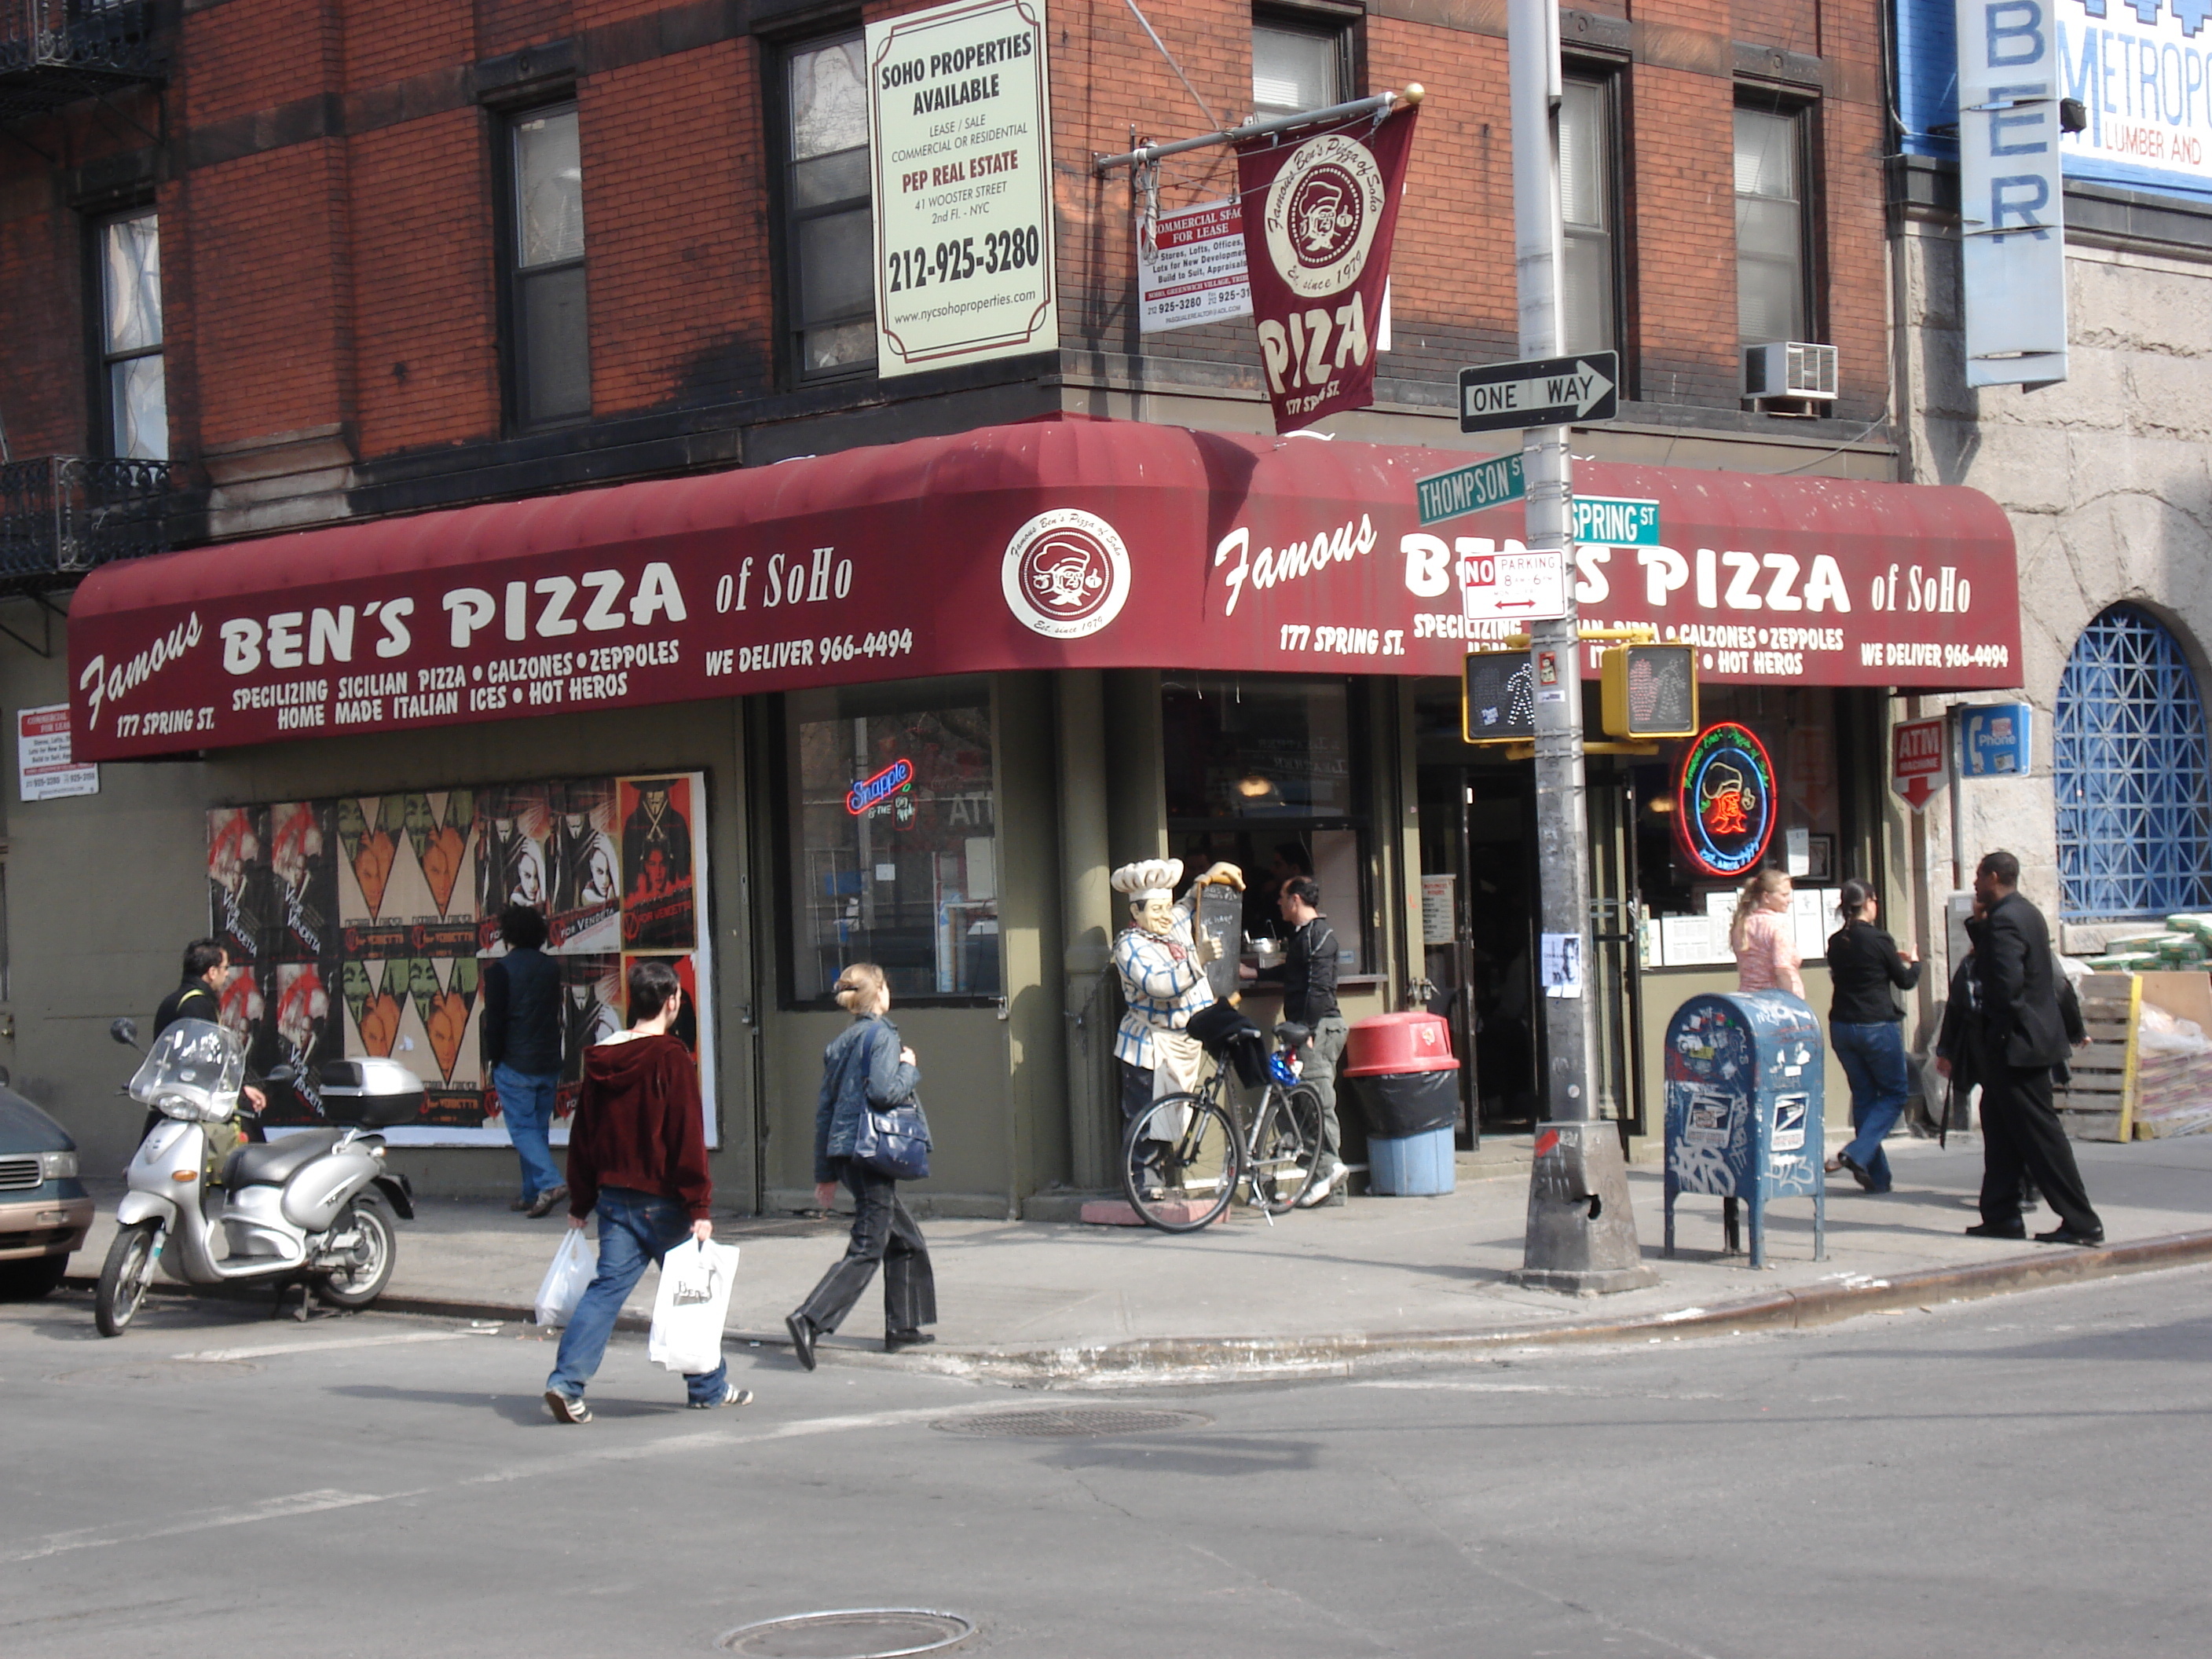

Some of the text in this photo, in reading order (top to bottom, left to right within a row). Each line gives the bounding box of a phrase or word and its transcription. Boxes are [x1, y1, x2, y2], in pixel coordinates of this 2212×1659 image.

[881, 31, 1032, 90] SOHO PROPERTIES
[913, 74, 1000, 115] AVAILABLE
[929, 120, 955, 137] LEASE
[965, 115, 986, 130] SALE
[892, 123, 1027, 163] COMMERCIAL OR RESIDENTIAL
[2105, 121, 2202, 165] LUMBER AND
[903, 149, 1018, 193] PEP REAL ESTATE
[1267, 170, 1295, 233] Famous
[1325, 137, 1359, 163] Pizza
[1357, 160, 1375, 176] of
[1367, 174, 1384, 213] Soho
[915, 181, 1007, 211] 41 WOOSTER STREET
[932, 210, 947, 225] 2nd
[970, 202, 990, 217] NYC
[1173, 223, 1229, 244] FOR LEASE
[1189, 245, 1210, 256] Lofts,
[1213, 239, 1243, 251] Offices,
[889, 225, 1039, 293] 212-925-3280
[1153, 263, 1168, 273] Lots
[1170, 262, 1180, 270] for
[1183, 257, 1199, 268] New
[1303, 250, 1362, 290] since 1979
[1158, 273, 1176, 284] Build
[1178, 271, 1186, 280] to
[895, 290, 1036, 324] www.nycsohoproperties.com
[1159, 296, 1202, 313] 925-3280
[1286, 379, 1340, 416] 177 ST.
[1474, 375, 1594, 412] ONE WAY
[1420, 461, 1510, 518] THOMPSON
[1010, 513, 1121, 557] Famous Ben's Pizza of Soho
[1572, 502, 1655, 543] SPRING ST
[1214, 513, 1378, 617] Famous
[1465, 558, 1494, 584] NO
[1501, 557, 1555, 570] PARKING
[1638, 547, 1851, 613] PIZZA
[1870, 562, 1899, 612] of
[1907, 564, 1971, 614] SoHo
[80, 547, 853, 731] Famous BEN'S PIZZA of SoHo
[1082, 616, 1103, 631] 1979
[1280, 624, 1405, 656] 177 SPRING ST.
[1679, 624, 1756, 649] CALZONES
[1770, 628, 1844, 651] ZEPPOLES
[705, 628, 914, 677] WE DELIVER 966-4494
[1718, 650, 1749, 674] HOT
[1753, 651, 1803, 676] HEROS
[1861, 643, 2009, 668] WE DELIVER 966-4494
[232, 639, 679, 712] SPECILIZING SICILIAN PIZZA CALZONES ZEPPOLES
[277, 672, 628, 731] HOME MADE ITALIAN ICES HOT HEROS
[117, 707, 214, 738] 177 SPRING ST.
[1899, 727, 1939, 759] ATM
[1979, 734, 2016, 747] Phone
[1899, 758, 1939, 771] MACHINE
[851, 762, 907, 809] Snapple
[877, 805, 892, 815] THE
[577, 906, 614, 931] VENDETTA
